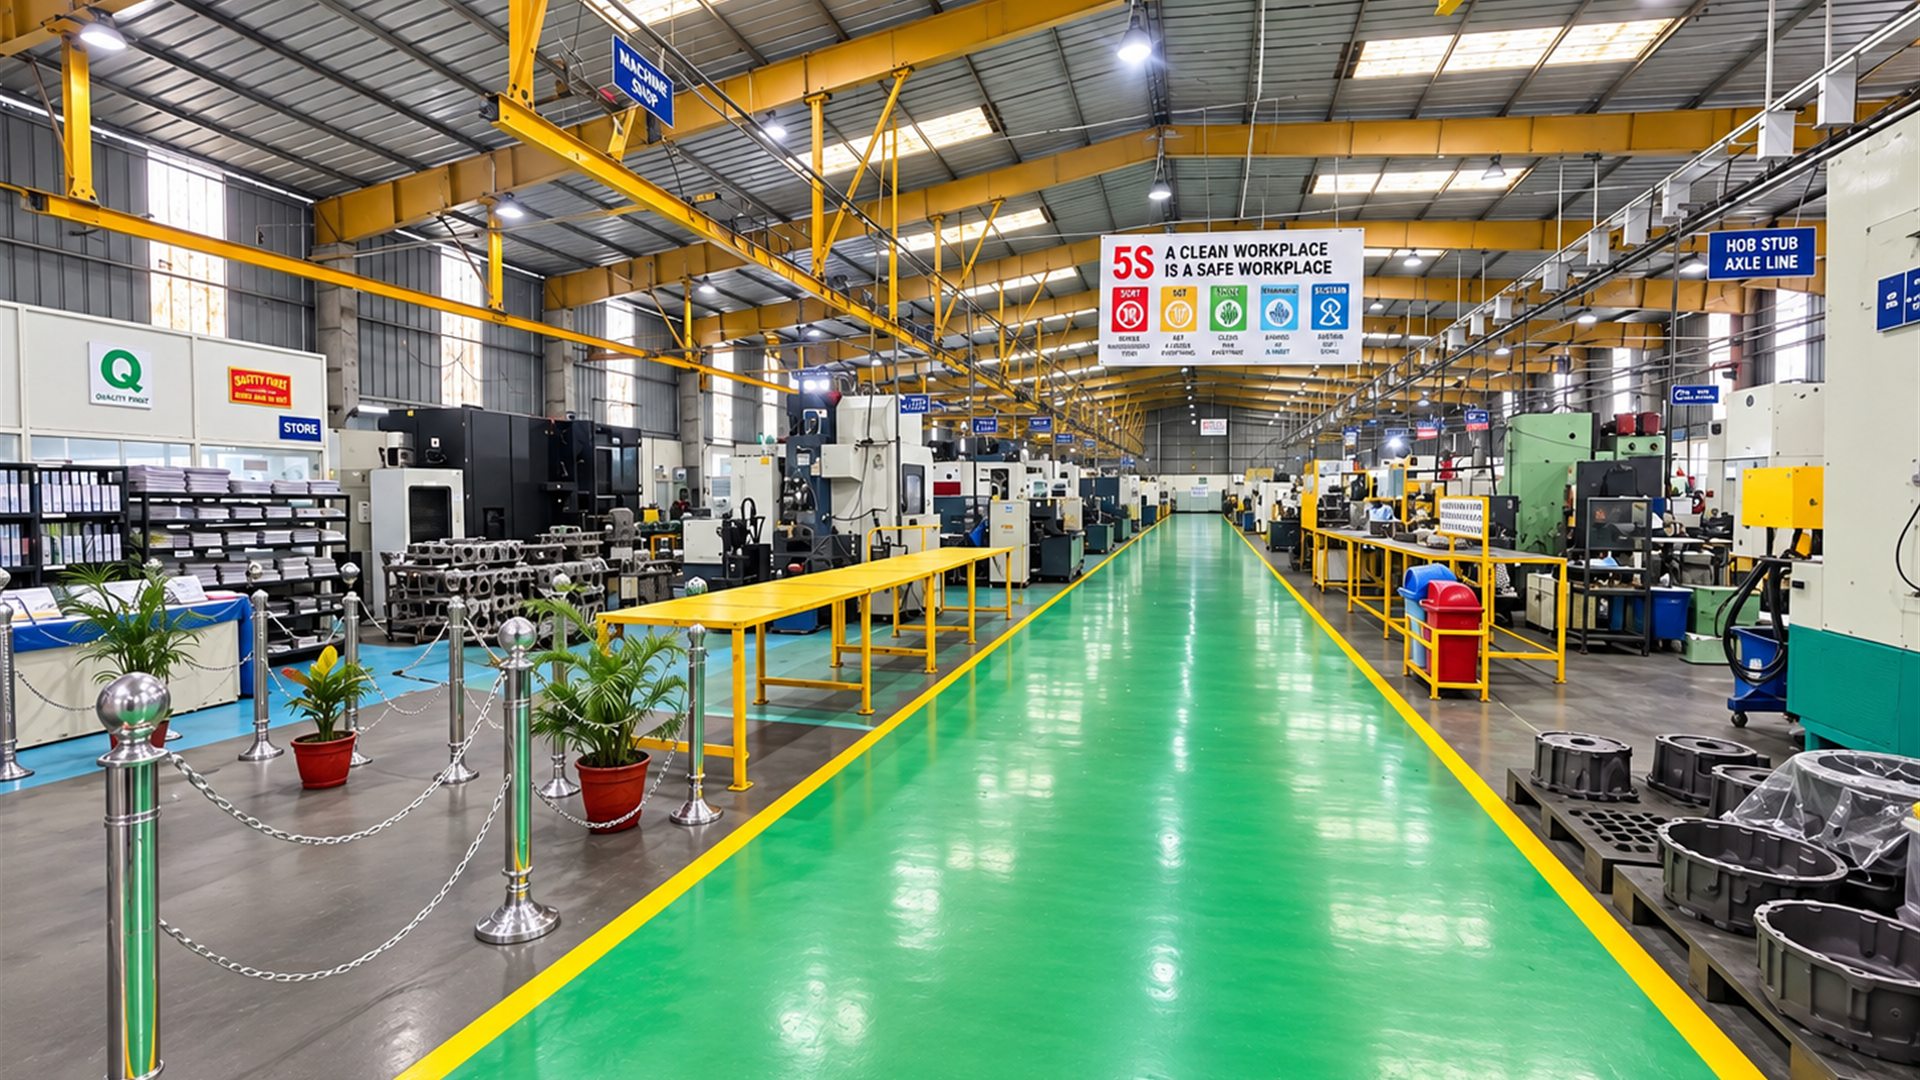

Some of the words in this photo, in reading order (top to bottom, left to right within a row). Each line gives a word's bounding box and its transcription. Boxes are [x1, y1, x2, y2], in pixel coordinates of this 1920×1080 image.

[1165, 246, 1176, 260] A
[1180, 244, 1229, 260] CLEAN
[1233, 242, 1328, 258] WORKPLACE
[1726, 238, 1756, 253] HOB
[1761, 236, 1798, 251] STUB
[1113, 245, 1154, 280] 5S
[1165, 263, 1178, 277] IS
[1182, 263, 1193, 277] A
[1197, 262, 1234, 277] SAFE
[1238, 260, 1332, 275] WORKPLACE
[1725, 256, 1761, 271] AXLE
[1766, 254, 1798, 269] LINE
[100, 349, 143, 393] Q
[284, 422, 318, 435] STORE
